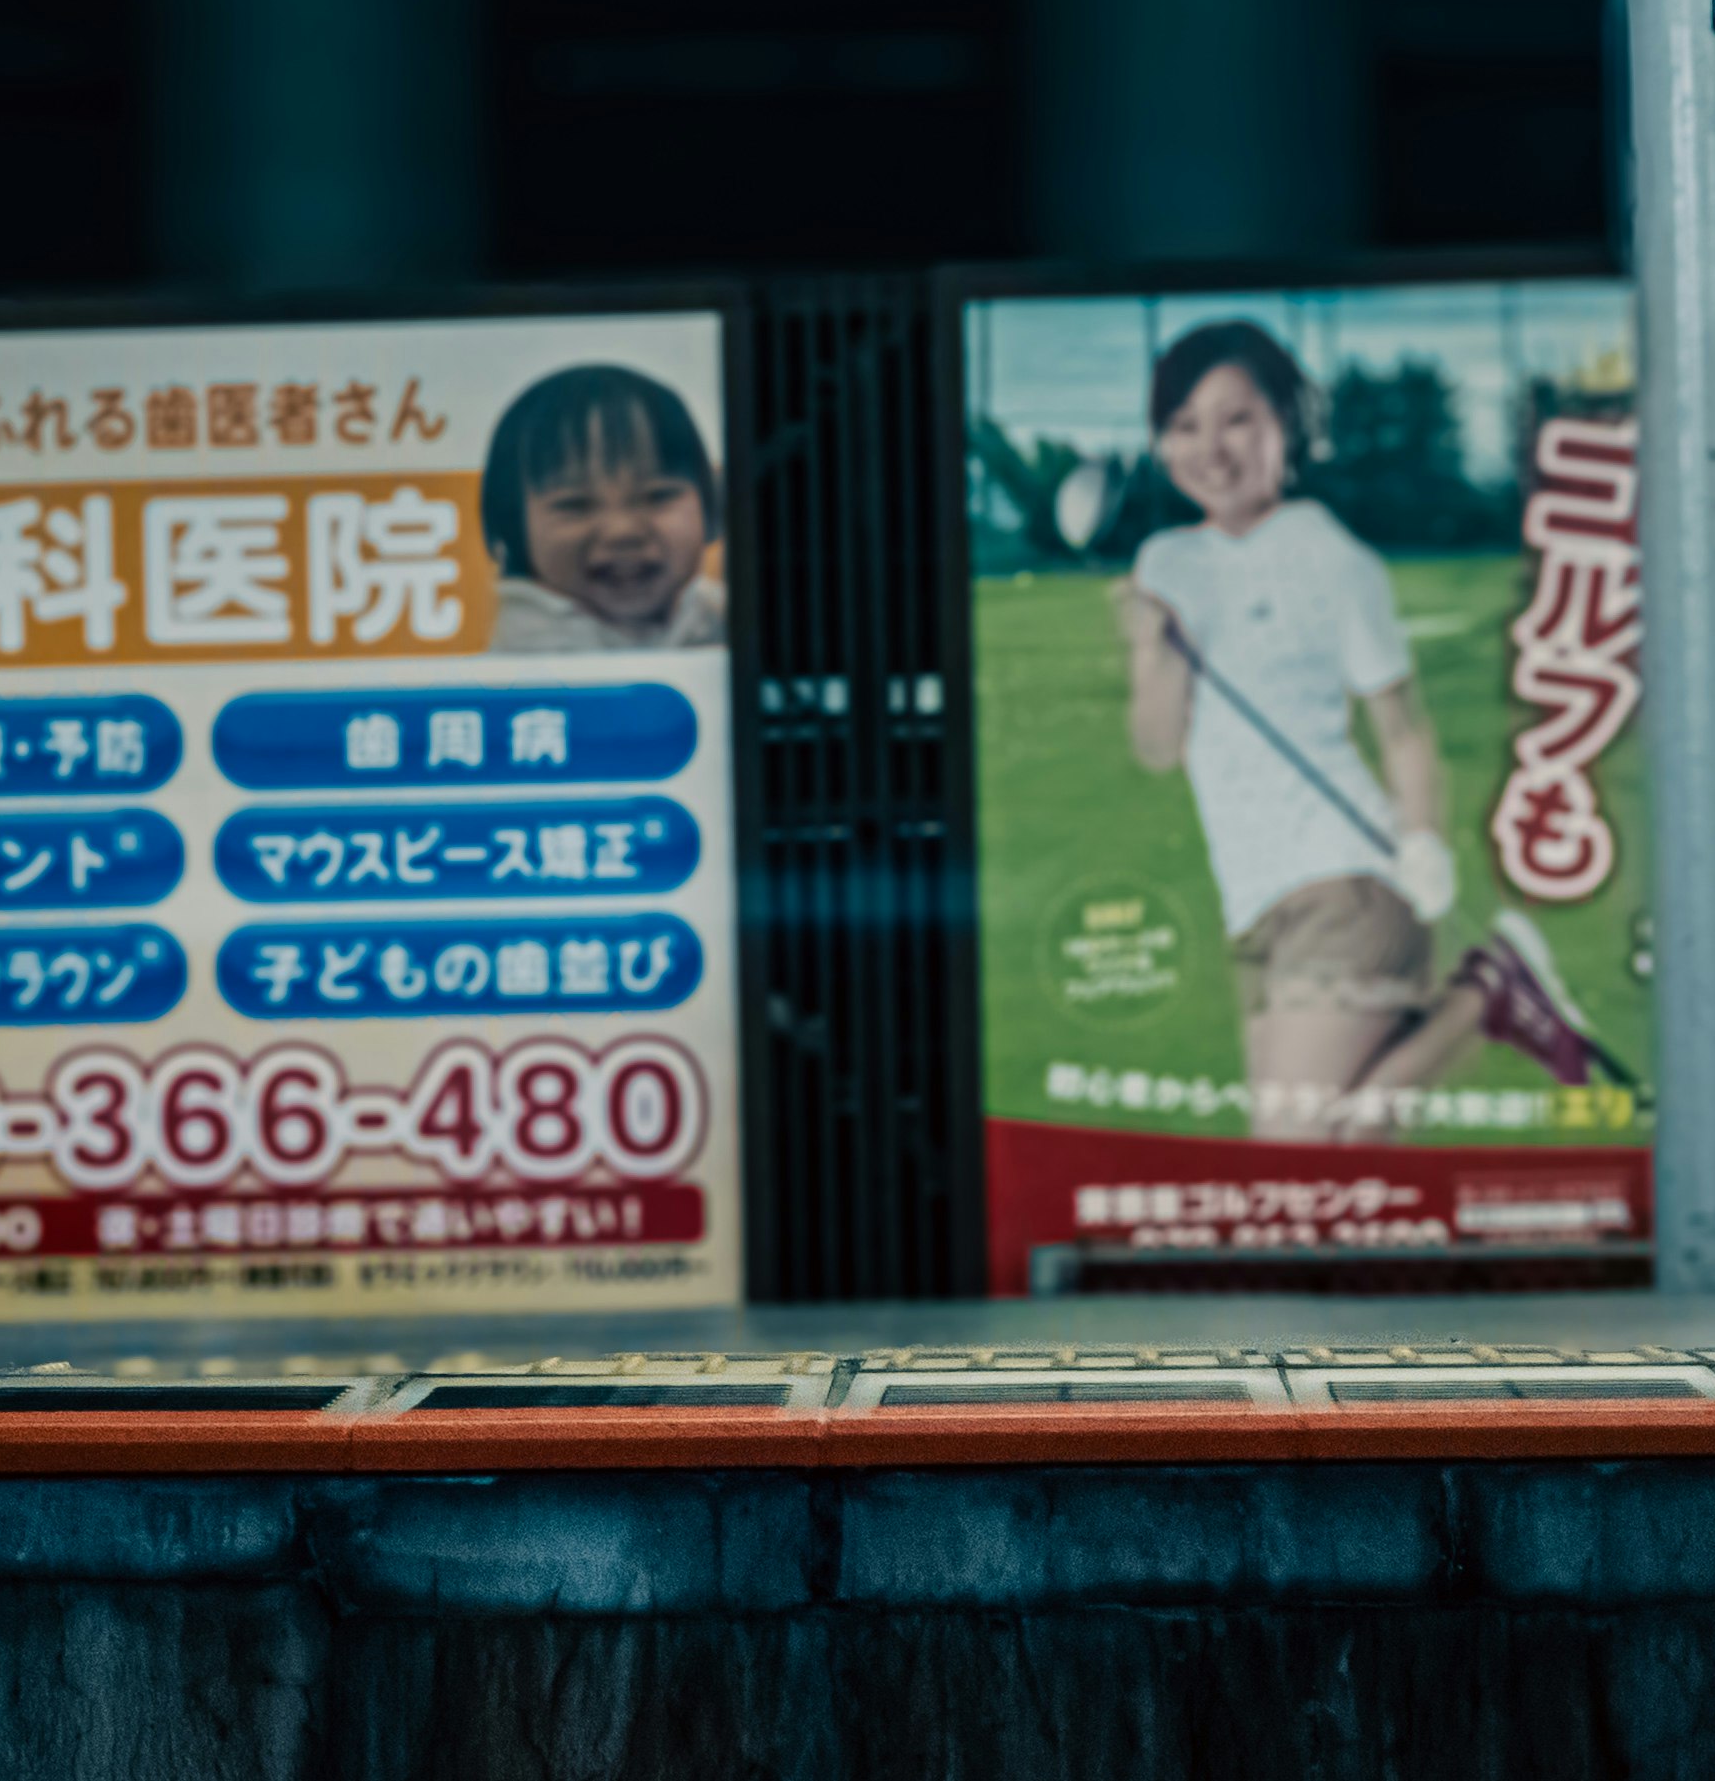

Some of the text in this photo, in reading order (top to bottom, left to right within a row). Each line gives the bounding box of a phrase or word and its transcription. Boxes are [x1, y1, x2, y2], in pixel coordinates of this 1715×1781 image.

[344, 707, 570, 771] 歯周病
[251, 820, 637, 887] マウスピース矯正
[253, 935, 673, 1005] 子どもの歯並び
